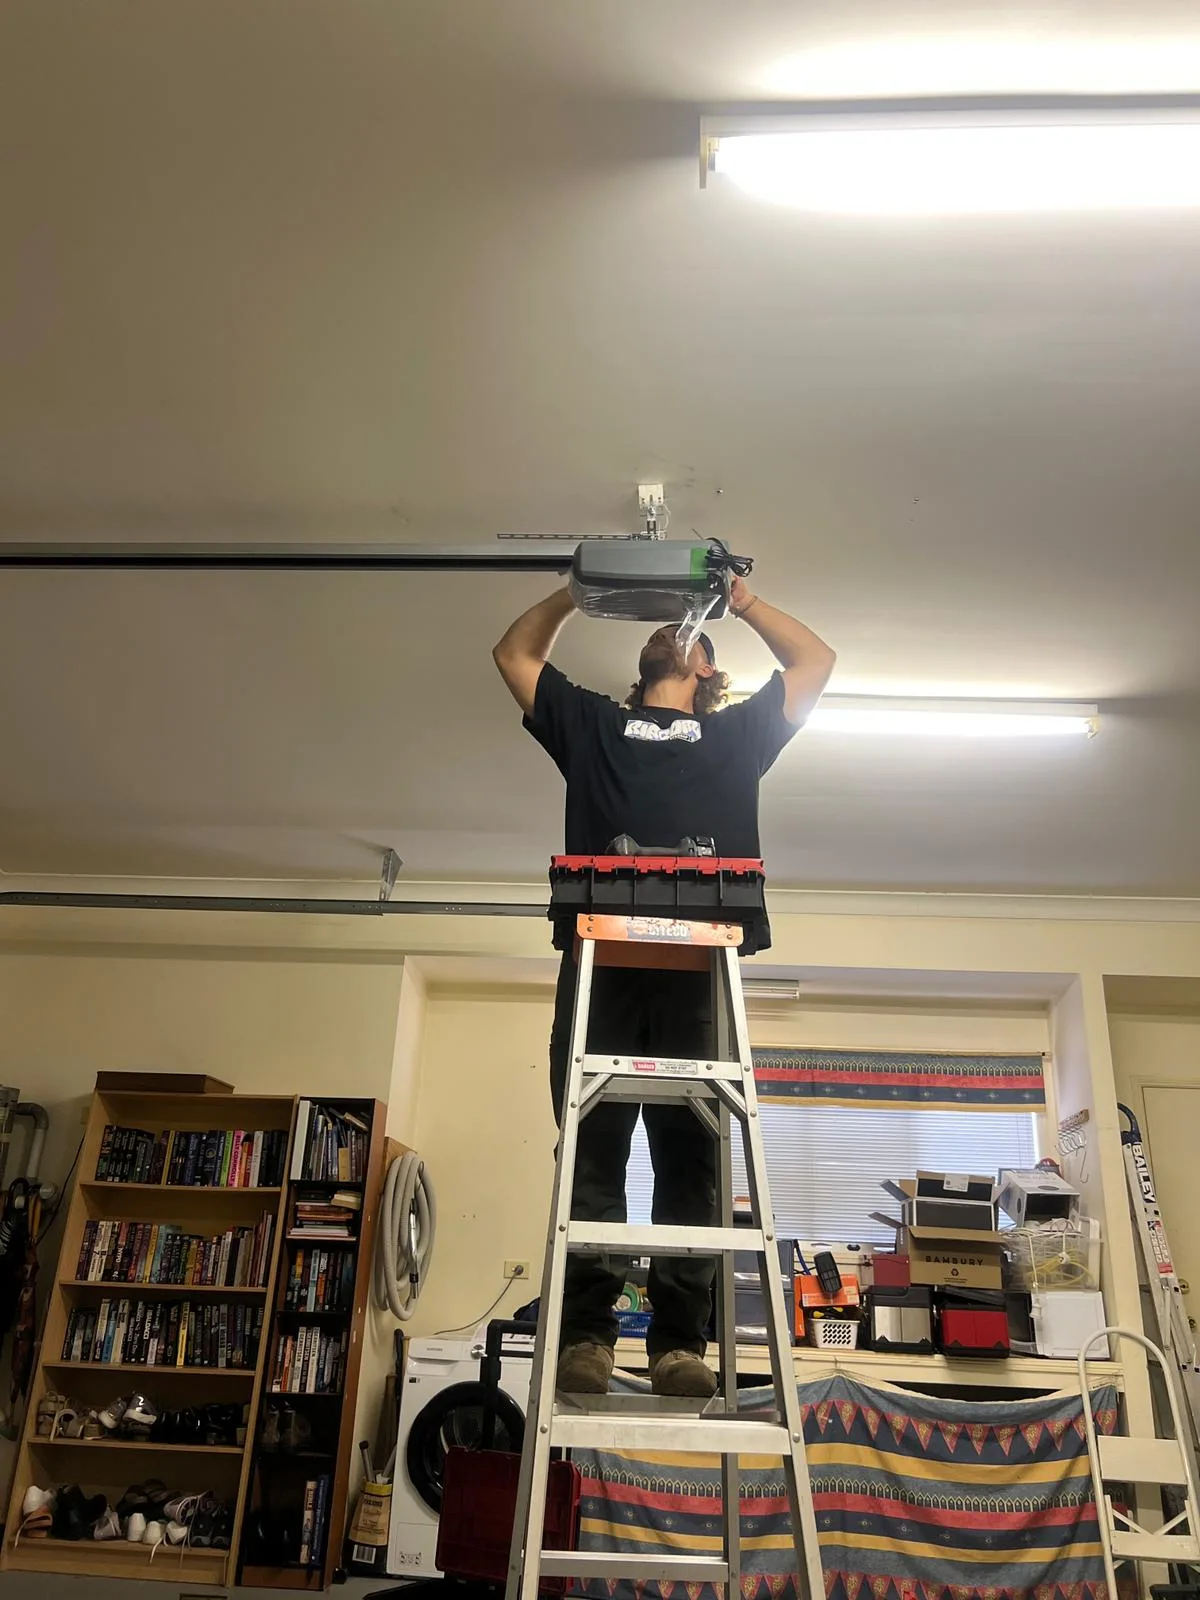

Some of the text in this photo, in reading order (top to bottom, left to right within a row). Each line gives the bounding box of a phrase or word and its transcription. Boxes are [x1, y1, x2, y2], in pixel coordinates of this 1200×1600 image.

[230, 1151, 239, 1182] CONNOLLY
[1132, 1144, 1156, 1202] BAILEY
[925, 1255, 983, 1266] BAMBURY
